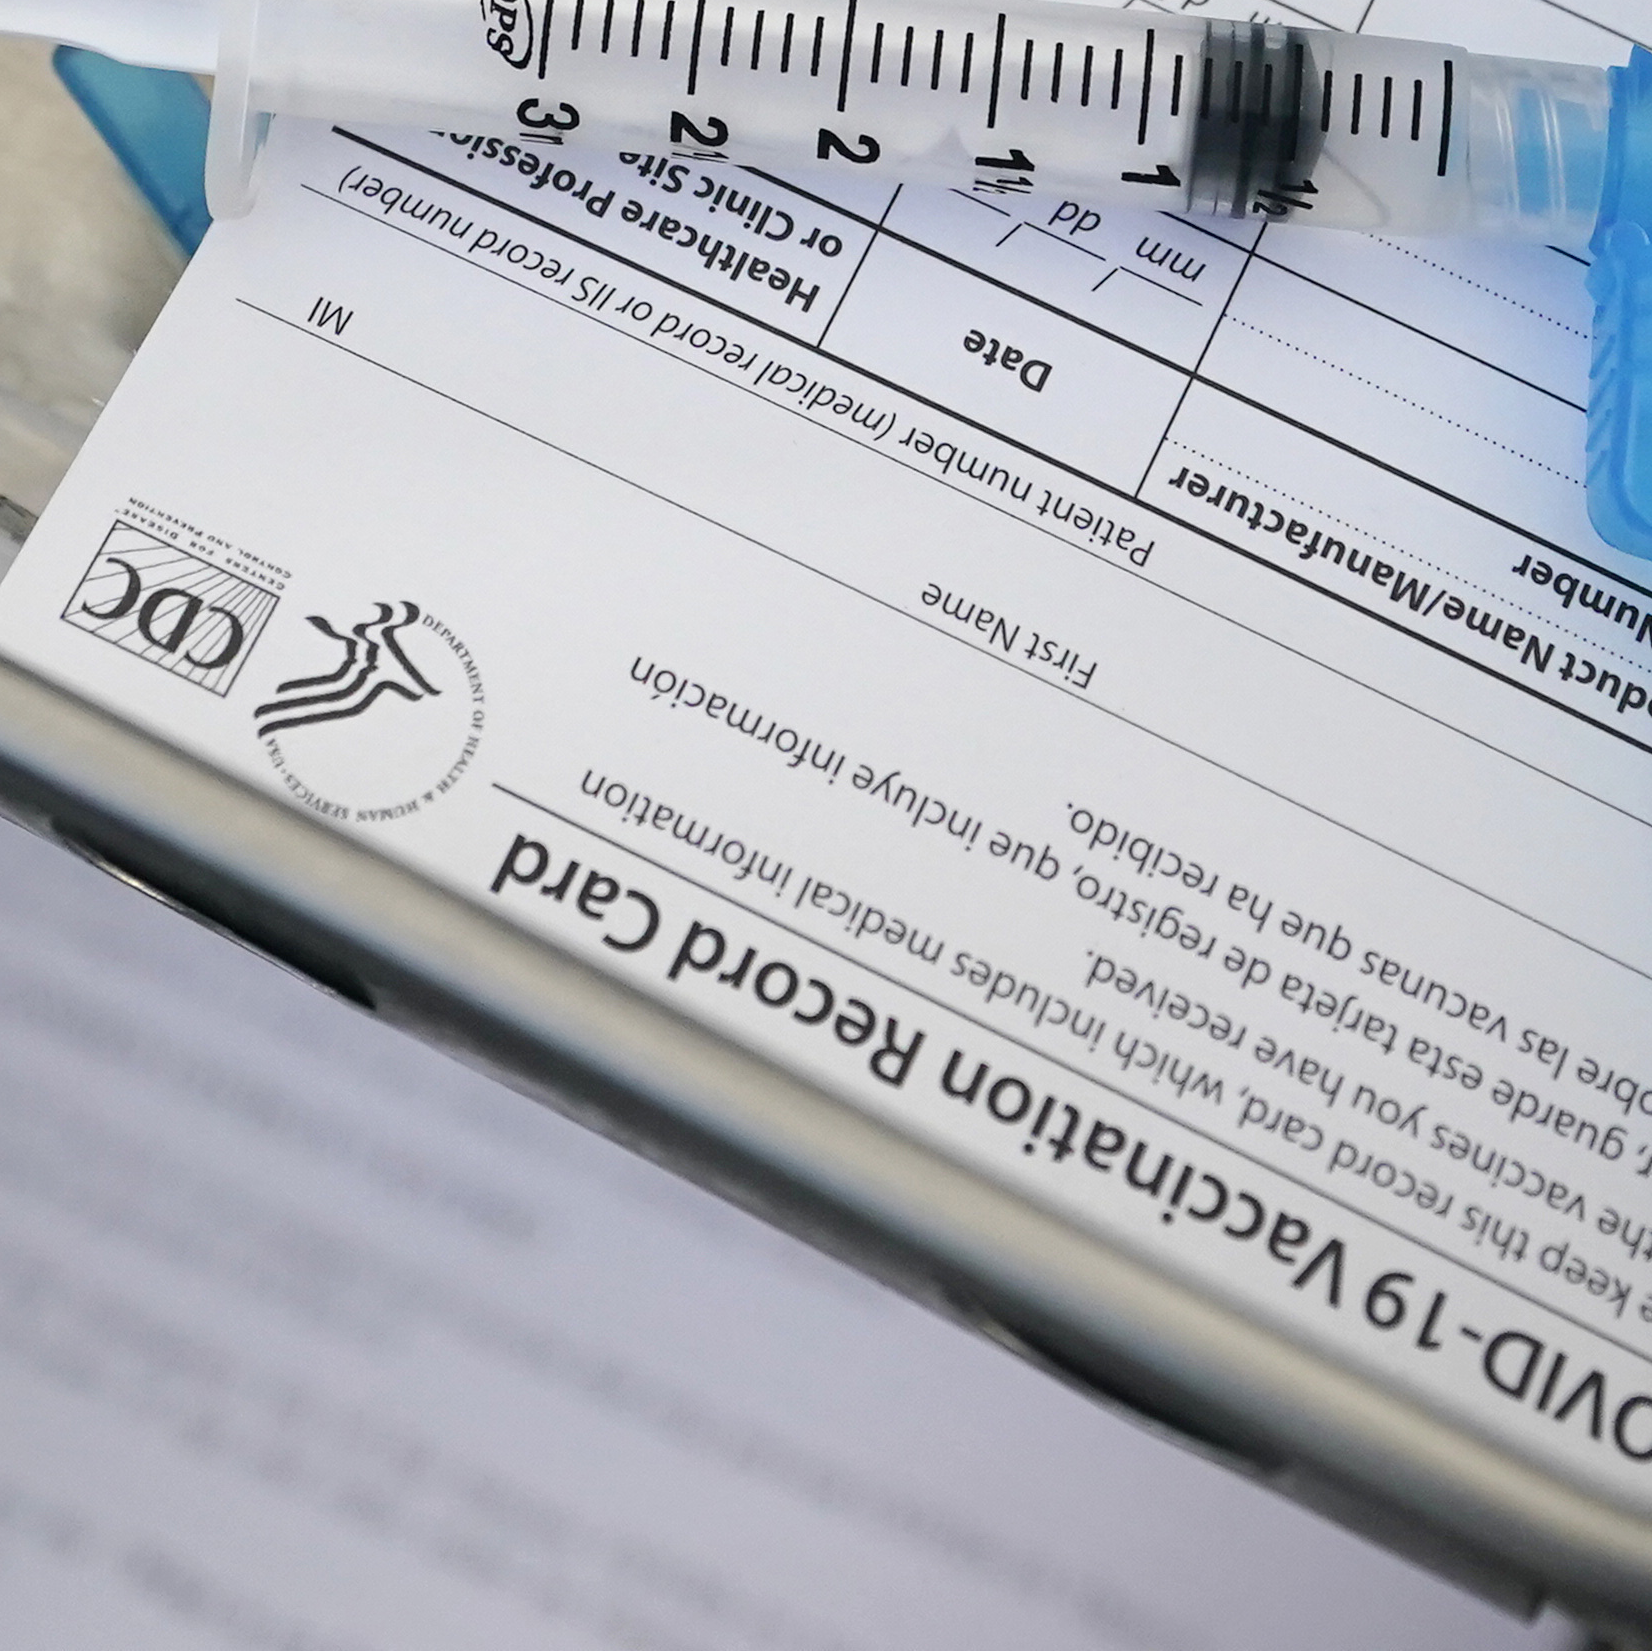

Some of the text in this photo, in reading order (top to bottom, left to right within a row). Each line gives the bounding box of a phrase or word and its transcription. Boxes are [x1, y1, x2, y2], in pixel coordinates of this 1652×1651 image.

[516, 97, 581, 131] 3
[816, 127, 882, 165] 2
[620, 153, 842, 257] or Clinic Site
[1120, 163, 1181, 188] 1
[622, 200, 820, 312] Healthcare
[1049, 201, 1205, 281] mm dd
[308, 298, 353, 335] MI
[339, 166, 1154, 566] Patient number (medical record or IIS record number)
[964, 330, 1051, 391] Date
[1169, 467, 1554, 673] Name/Manufacturer
[80, 556, 246, 670] CDC
[922, 584, 1096, 689] First Name
[422, 614, 486, 705] DEPARTMENT
[472, 709, 487, 735] OF
[631, 657, 845, 784] información
[582, 770, 792, 897] information
[853, 765, 981, 851] incluye
[989, 831, 1059, 880] que
[1068, 803, 1218, 896] recibido.
[490, 833, 660, 953] Card
[794, 877, 944, 964] medical
[1073, 866, 1216, 958] registro,
[1228, 884, 1273, 933] ha
[1223, 946, 1271, 988] de
[1281, 911, 1351, 960] que
[667, 920, 926, 1089] Record
[951, 952, 1106, 1052] includes
[1086, 951, 1246, 1049] received.
[1280, 974, 1397, 1054] tarjeta
[1361, 951, 1505, 1042] vacunas
[1114, 1031, 1222, 1104] which
[1254, 1037, 1344, 1107] have
[1408, 1037, 1482, 1089] esta
[1517, 1029, 1568, 1080] las
[1238, 1087, 1323, 1151] card,
[1352, 1085, 1427, 1138] you
[1492, 1079, 1628, 1160] guarde
[940, 1048, 1345, 1309] Vaccination
[1328, 1140, 1454, 1217] record
[1431, 1124, 1584, 1221] vaccines
[1460, 1205, 1529, 1261] this
[1538, 1243, 1631, 1318] keep
